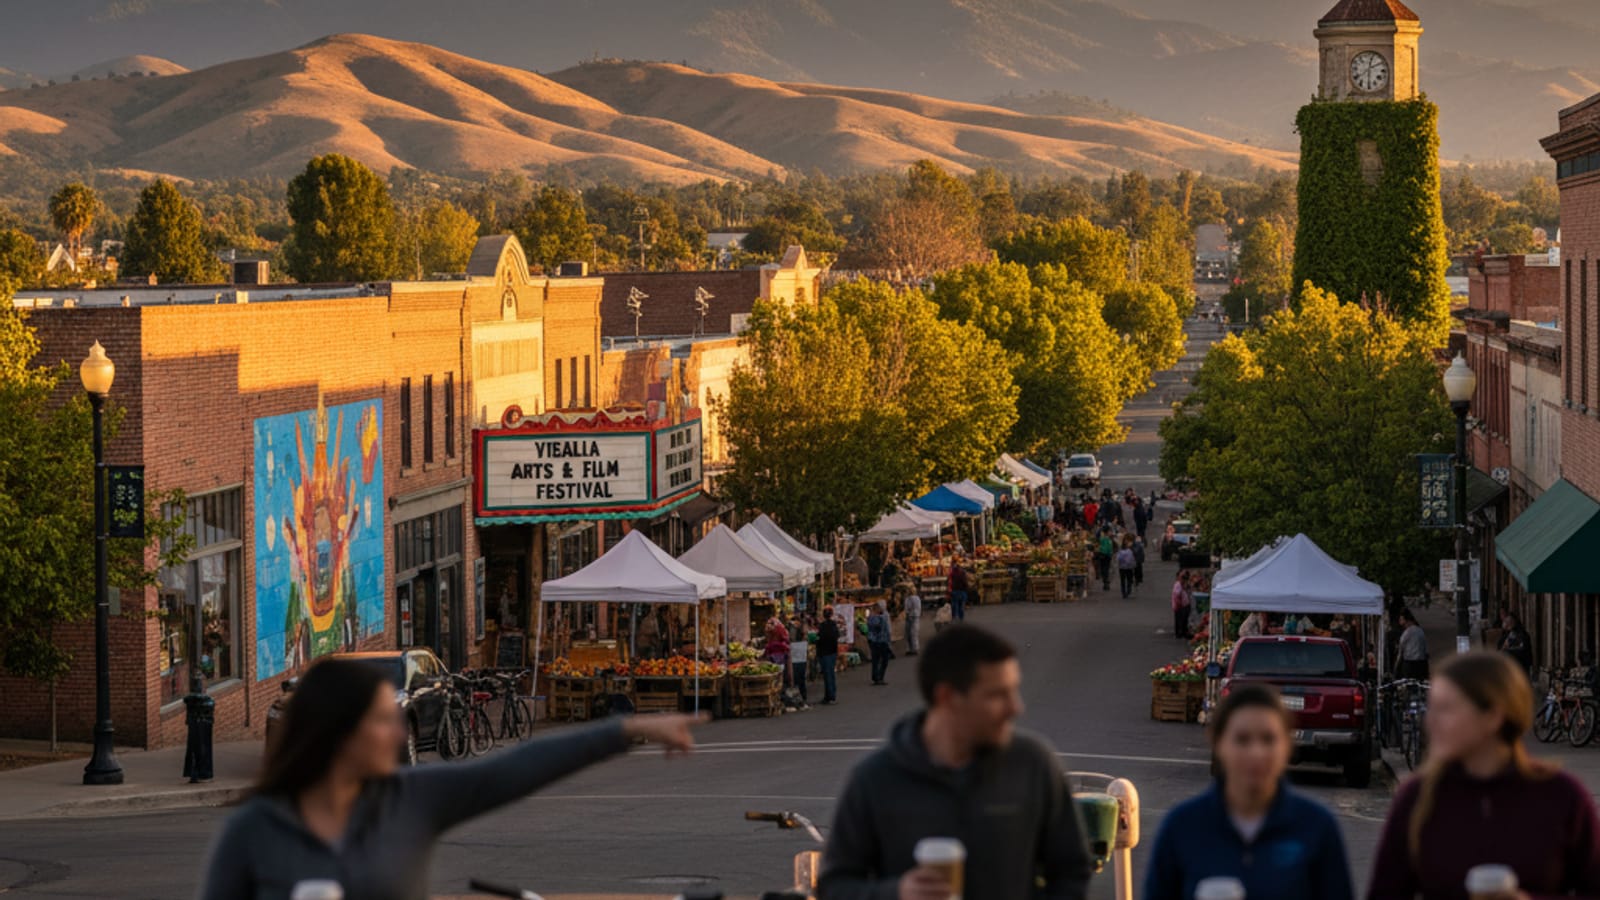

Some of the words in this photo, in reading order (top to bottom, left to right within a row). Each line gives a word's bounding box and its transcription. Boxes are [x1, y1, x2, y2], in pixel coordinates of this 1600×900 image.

[511, 463, 554, 480] ARTS
[562, 462, 574, 479] &
[536, 481, 613, 500] FESTIVAL
